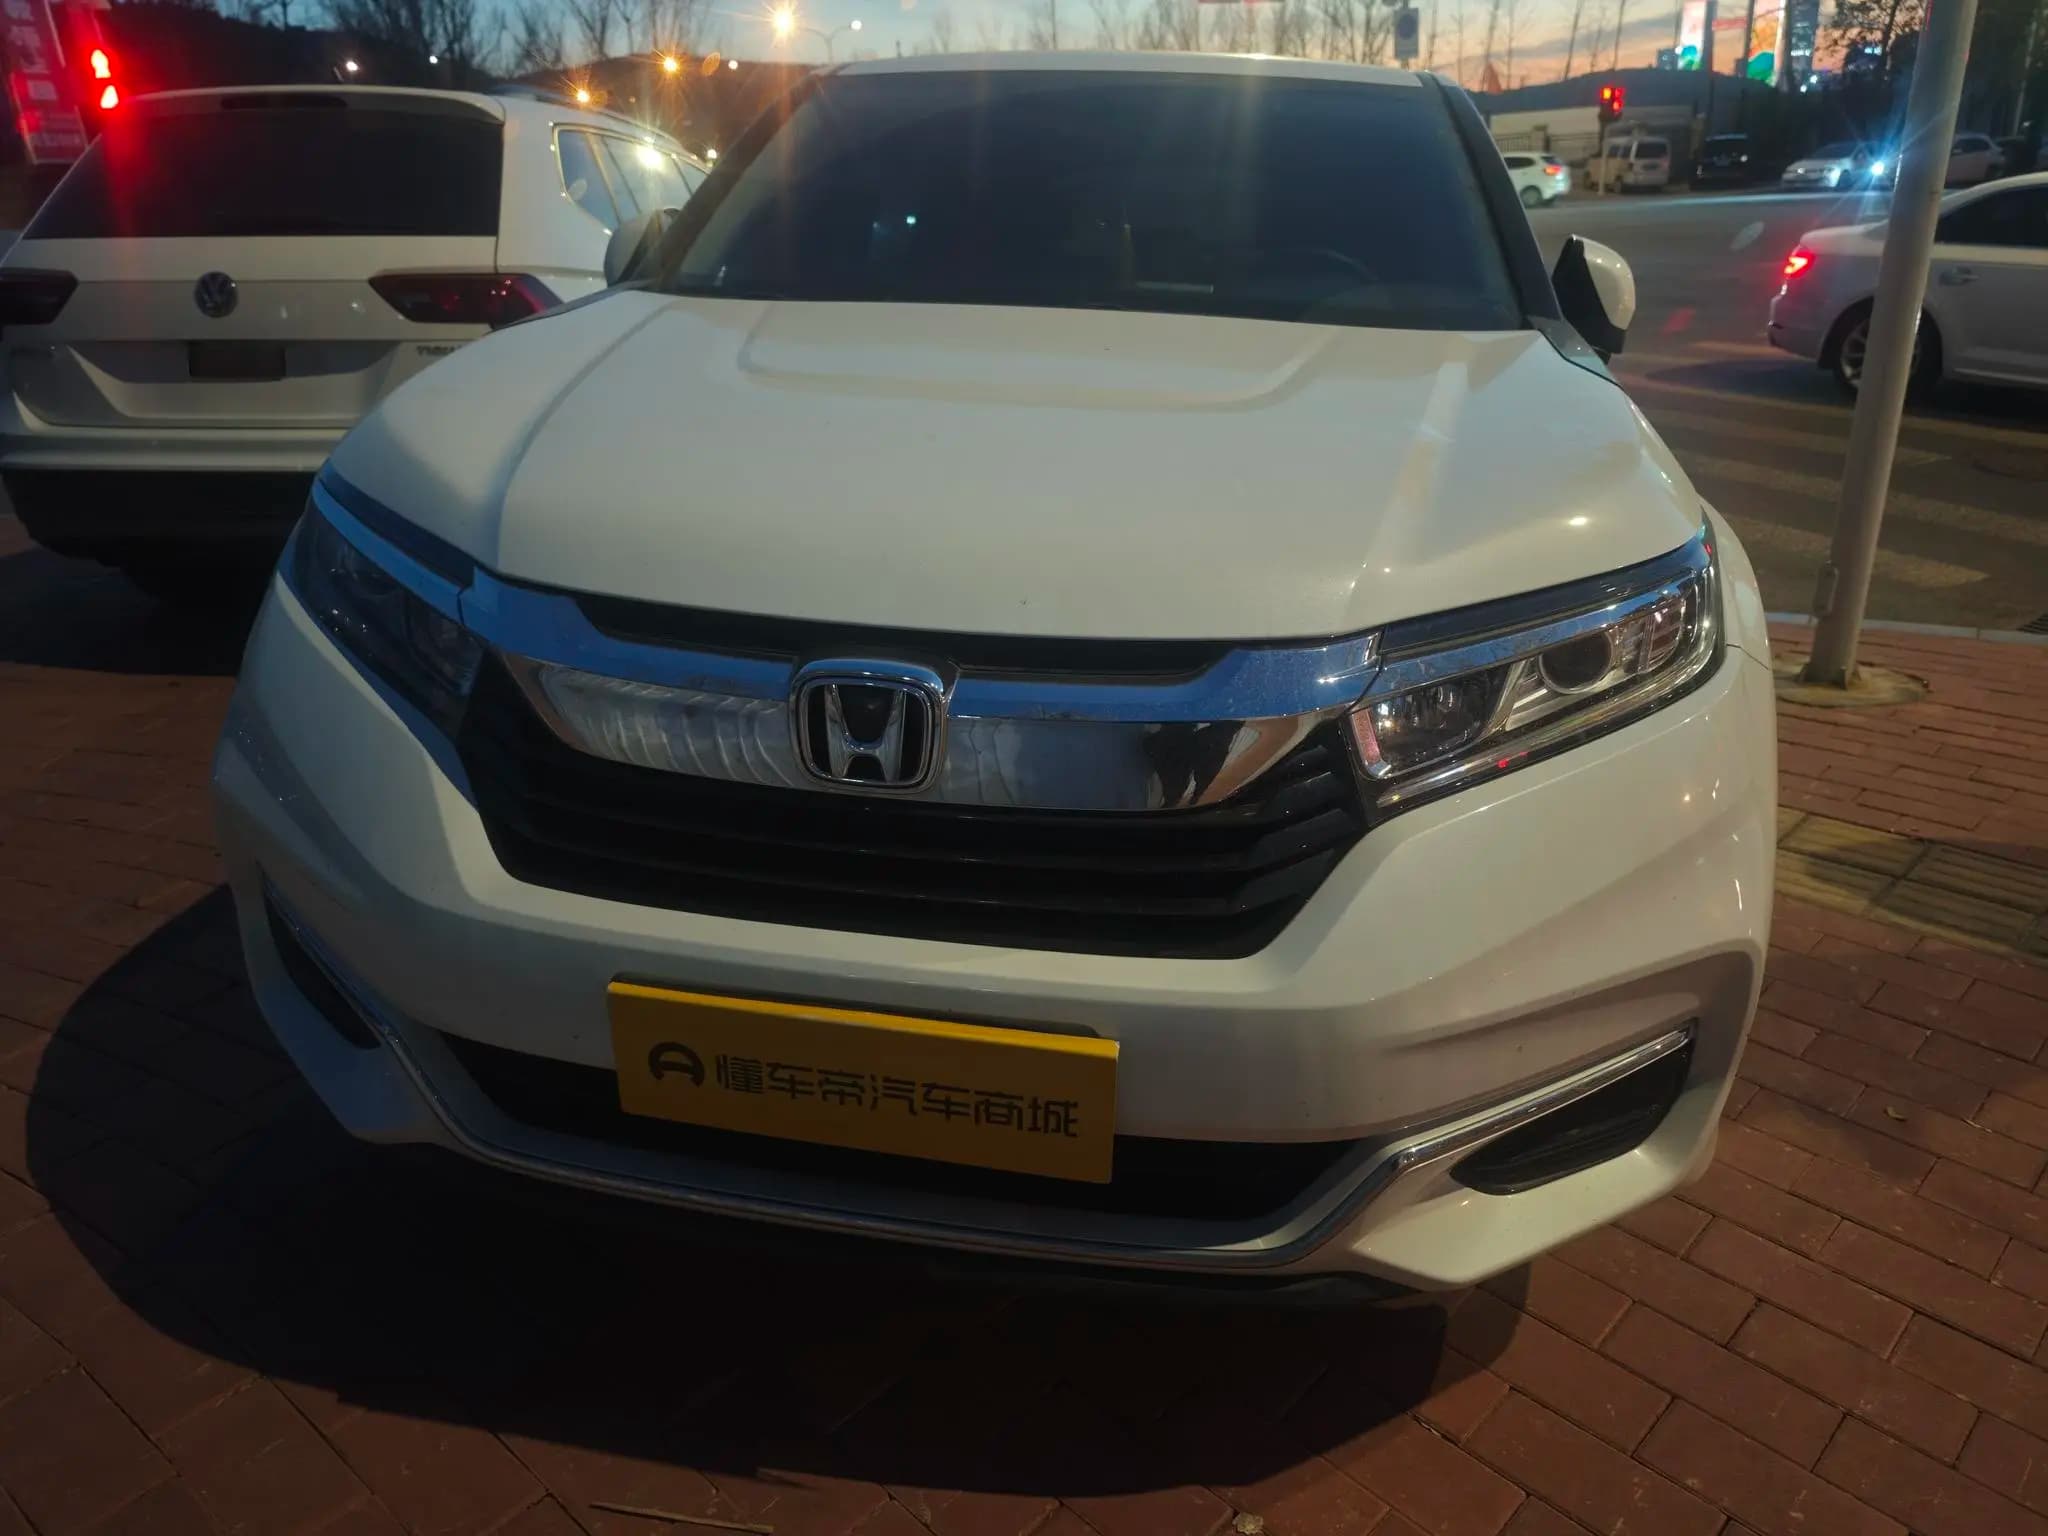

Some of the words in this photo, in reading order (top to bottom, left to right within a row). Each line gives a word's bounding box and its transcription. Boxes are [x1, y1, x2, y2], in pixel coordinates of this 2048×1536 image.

[715, 1054, 1079, 1138] 懂车帝汽车商城
